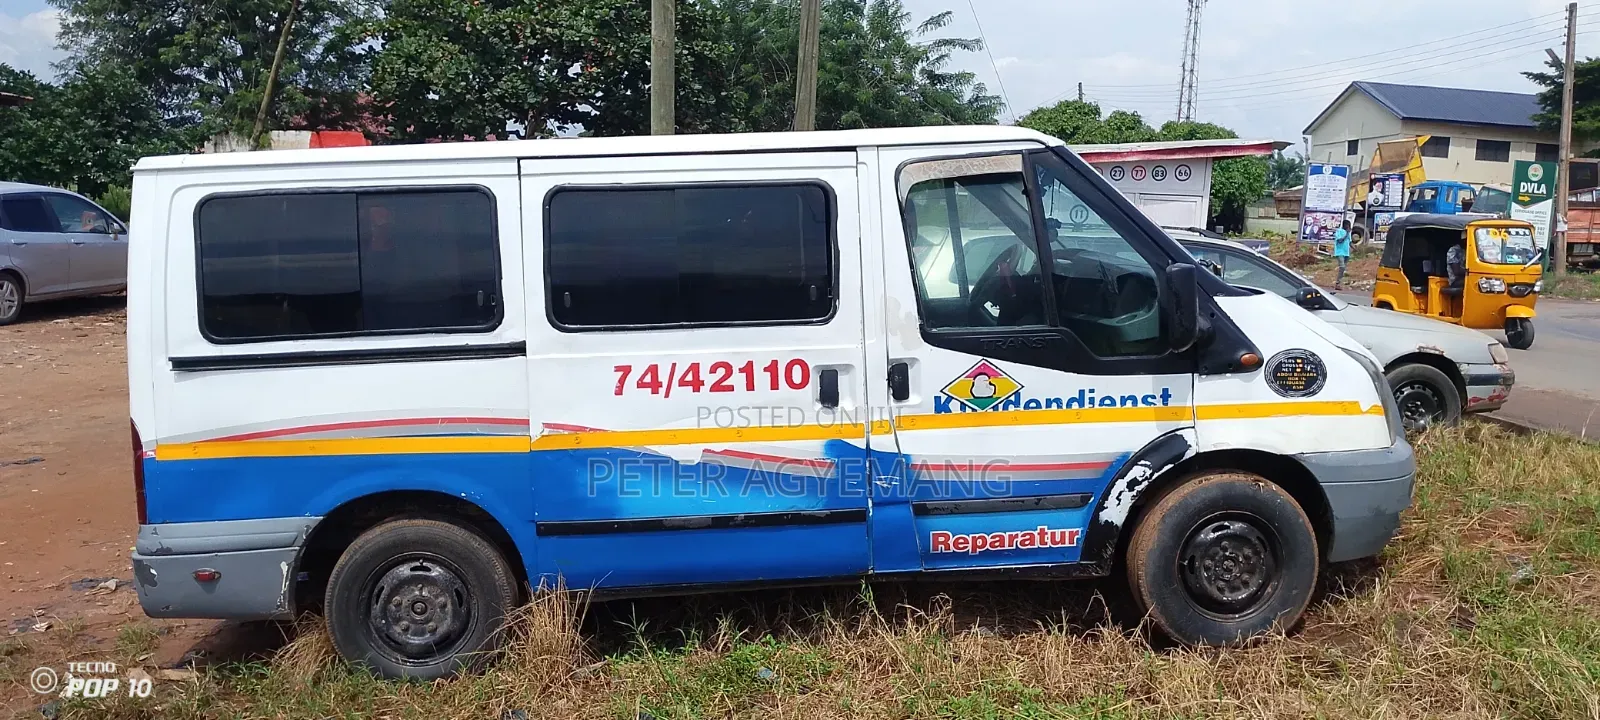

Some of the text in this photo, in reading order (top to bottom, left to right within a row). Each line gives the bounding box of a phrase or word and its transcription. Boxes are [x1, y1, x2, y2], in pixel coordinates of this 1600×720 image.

[1112, 168, 1189, 178] 27 77 83 66
[1520, 182, 1547, 194] DVLA
[613, 358, 811, 398] 74/42110
[930, 526, 1081, 554] Reparatur
